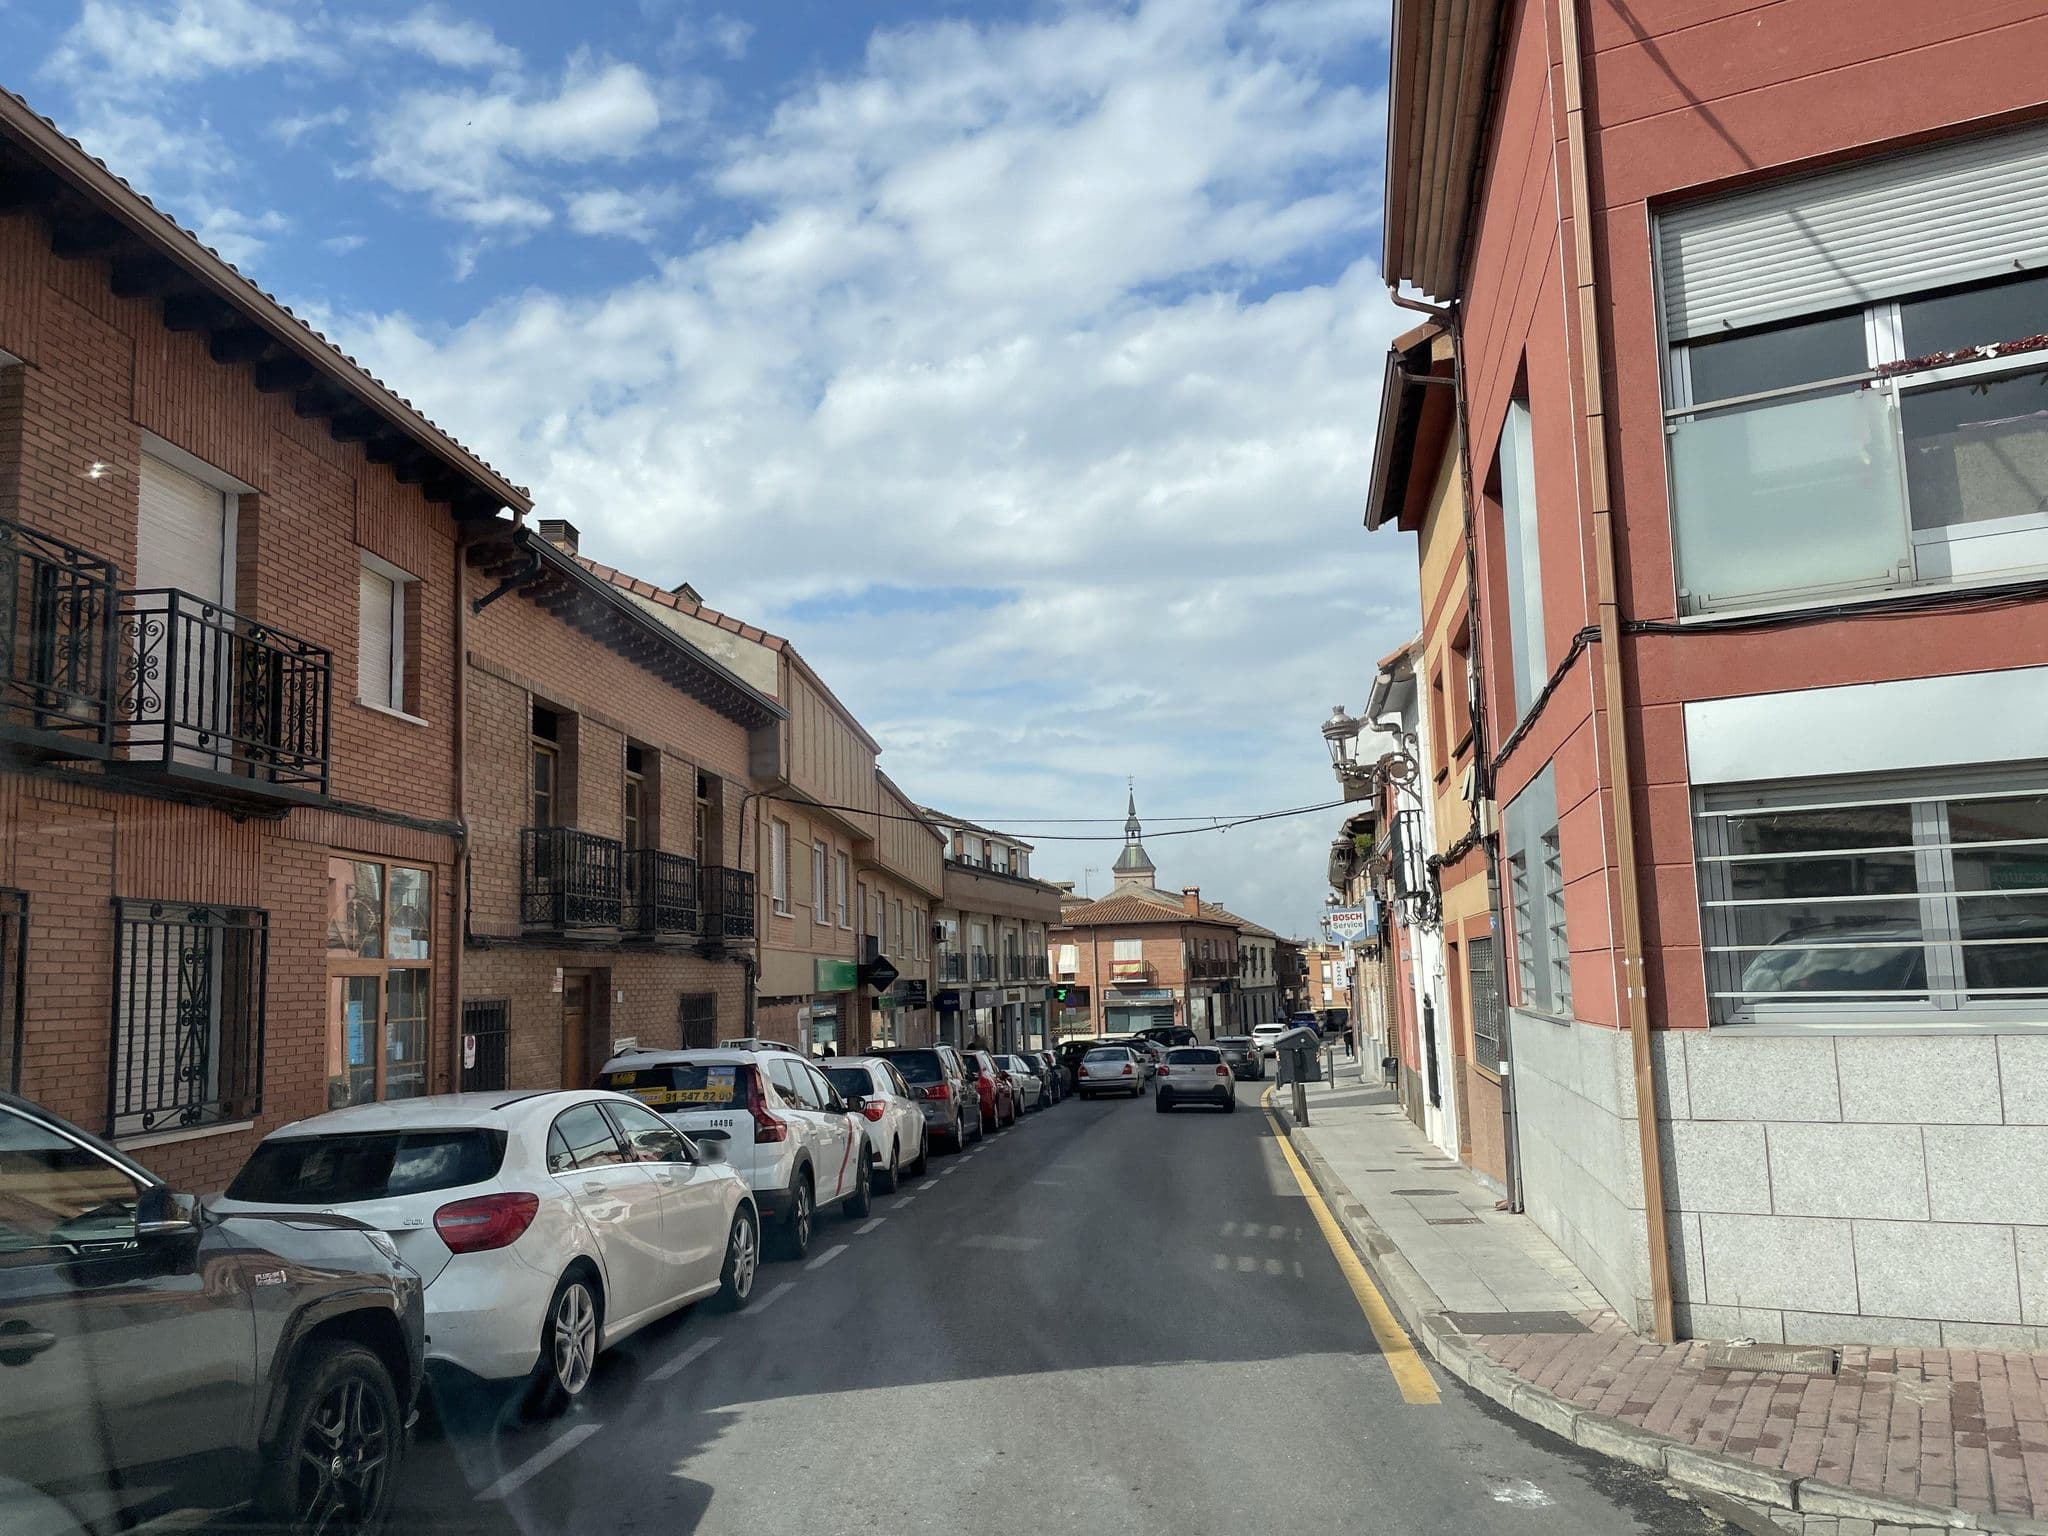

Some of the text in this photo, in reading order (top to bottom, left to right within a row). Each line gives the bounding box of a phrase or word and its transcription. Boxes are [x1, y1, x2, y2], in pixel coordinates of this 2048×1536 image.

[1332, 913, 1362, 921] BOSCH
[1332, 921, 1363, 929] Service
[665, 1092, 677, 1103] 91
[681, 1092, 700, 1102] 547
[703, 1091, 716, 1101] 82
